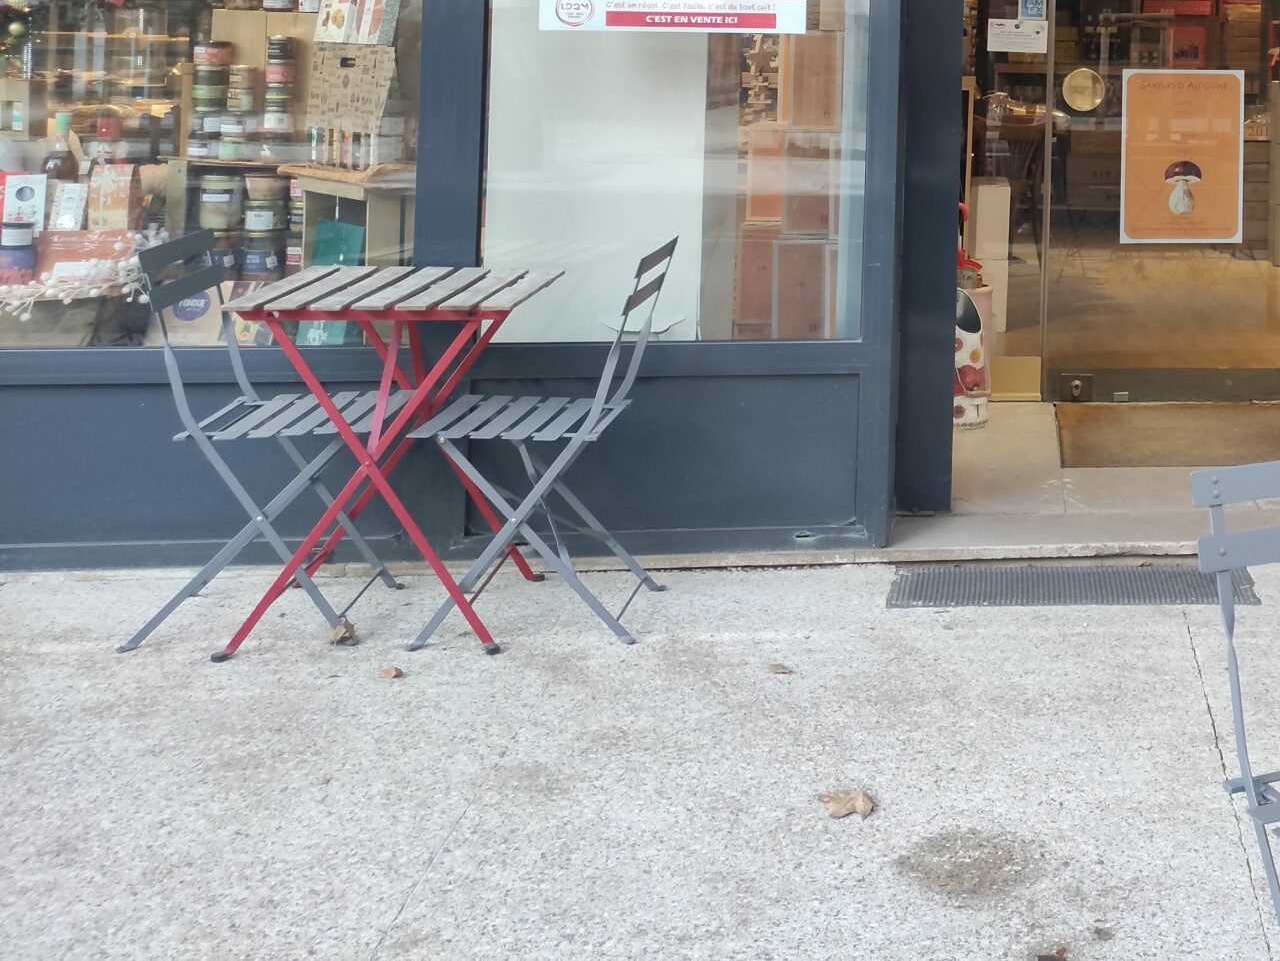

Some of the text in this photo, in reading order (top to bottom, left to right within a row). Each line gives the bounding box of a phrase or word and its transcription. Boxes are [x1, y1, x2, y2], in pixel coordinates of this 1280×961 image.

[645, 15, 738, 24] C'EST EN VENTE ICI
